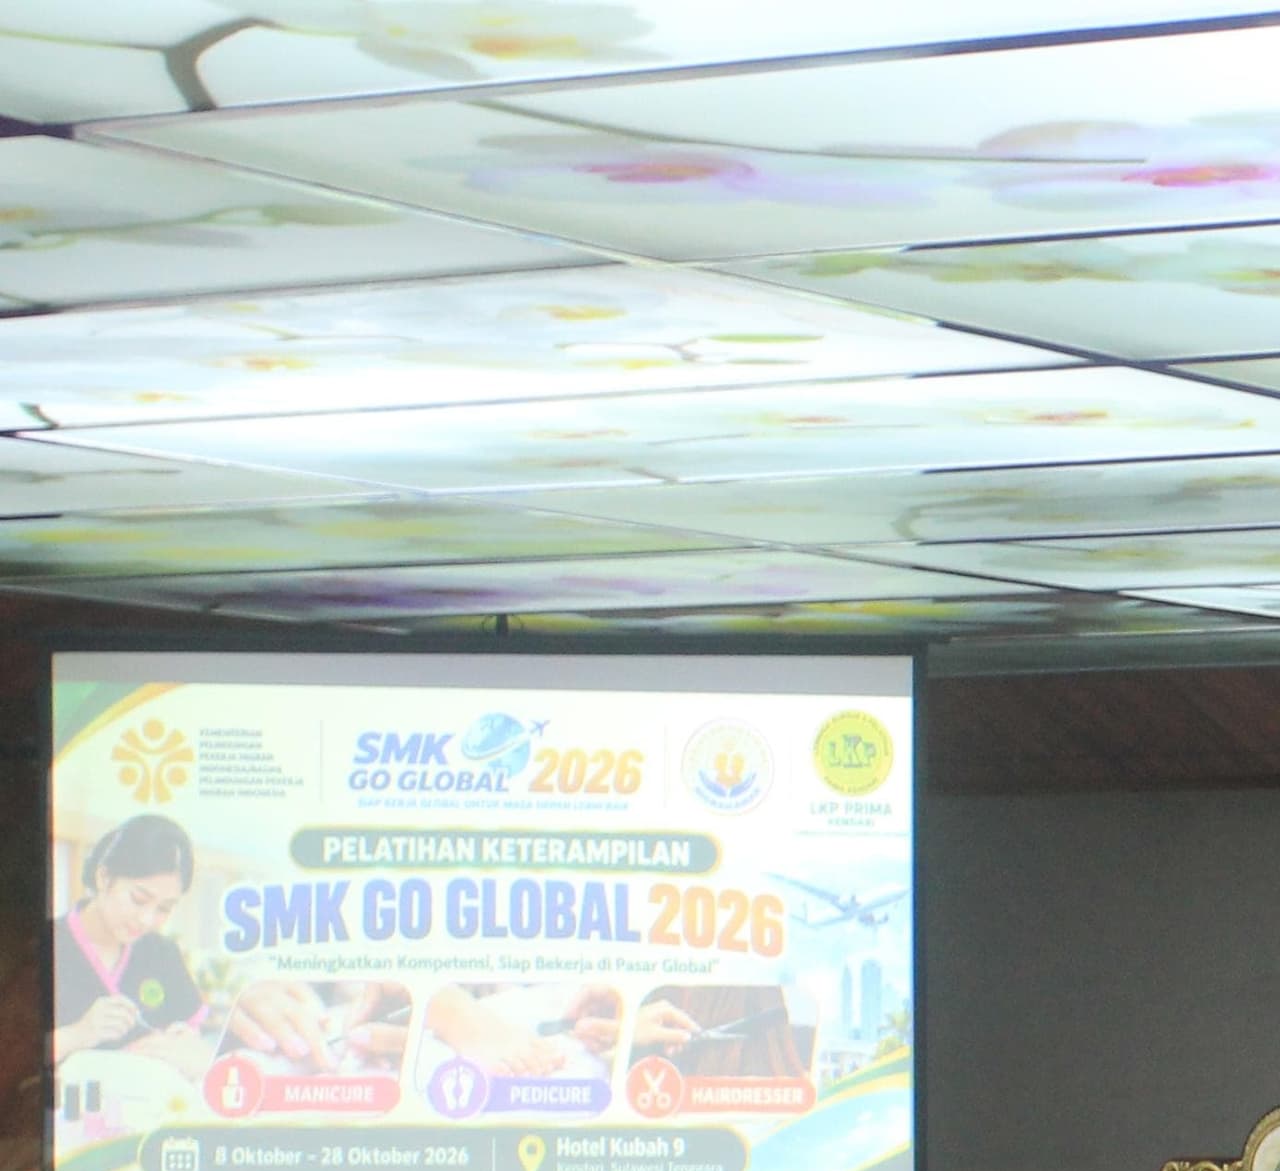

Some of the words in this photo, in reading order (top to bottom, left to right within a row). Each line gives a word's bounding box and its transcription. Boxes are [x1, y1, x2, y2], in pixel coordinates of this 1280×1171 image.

[352, 731, 456, 766] SMK
[528, 747, 645, 795] 2026
[348, 769, 392, 792] GO
[397, 767, 510, 793] GLOBAL
[810, 801, 840, 815] LKP
[844, 802, 893, 816] PRIMA
[323, 836, 475, 864] PELATIHAN
[480, 837, 690, 866] KETERAMPILAN
[224, 880, 351, 953] SMK
[362, 877, 432, 942] GO
[446, 877, 641, 943] GLOBAL
[648, 883, 784, 958] 2026
[397, 955, 494, 973] Kompetensi,
[498, 955, 530, 972] Siap
[535, 956, 593, 973] Bekerja
[597, 956, 611, 971] di
[616, 957, 657, 972] Pasar
[284, 1085, 374, 1103] MANICURE
[510, 1086, 592, 1104] PEDICURE
[692, 1087, 803, 1104] HAIRDRESSER
[232, 1146, 301, 1166] Oktober
[321, 1147, 343, 1166] 28
[348, 1147, 419, 1166] Oktober
[424, 1146, 469, 1166] 2026
[556, 1137, 606, 1158] Hotel
[611, 1137, 669, 1158] Kubah
[673, 1138, 686, 1158] 9
